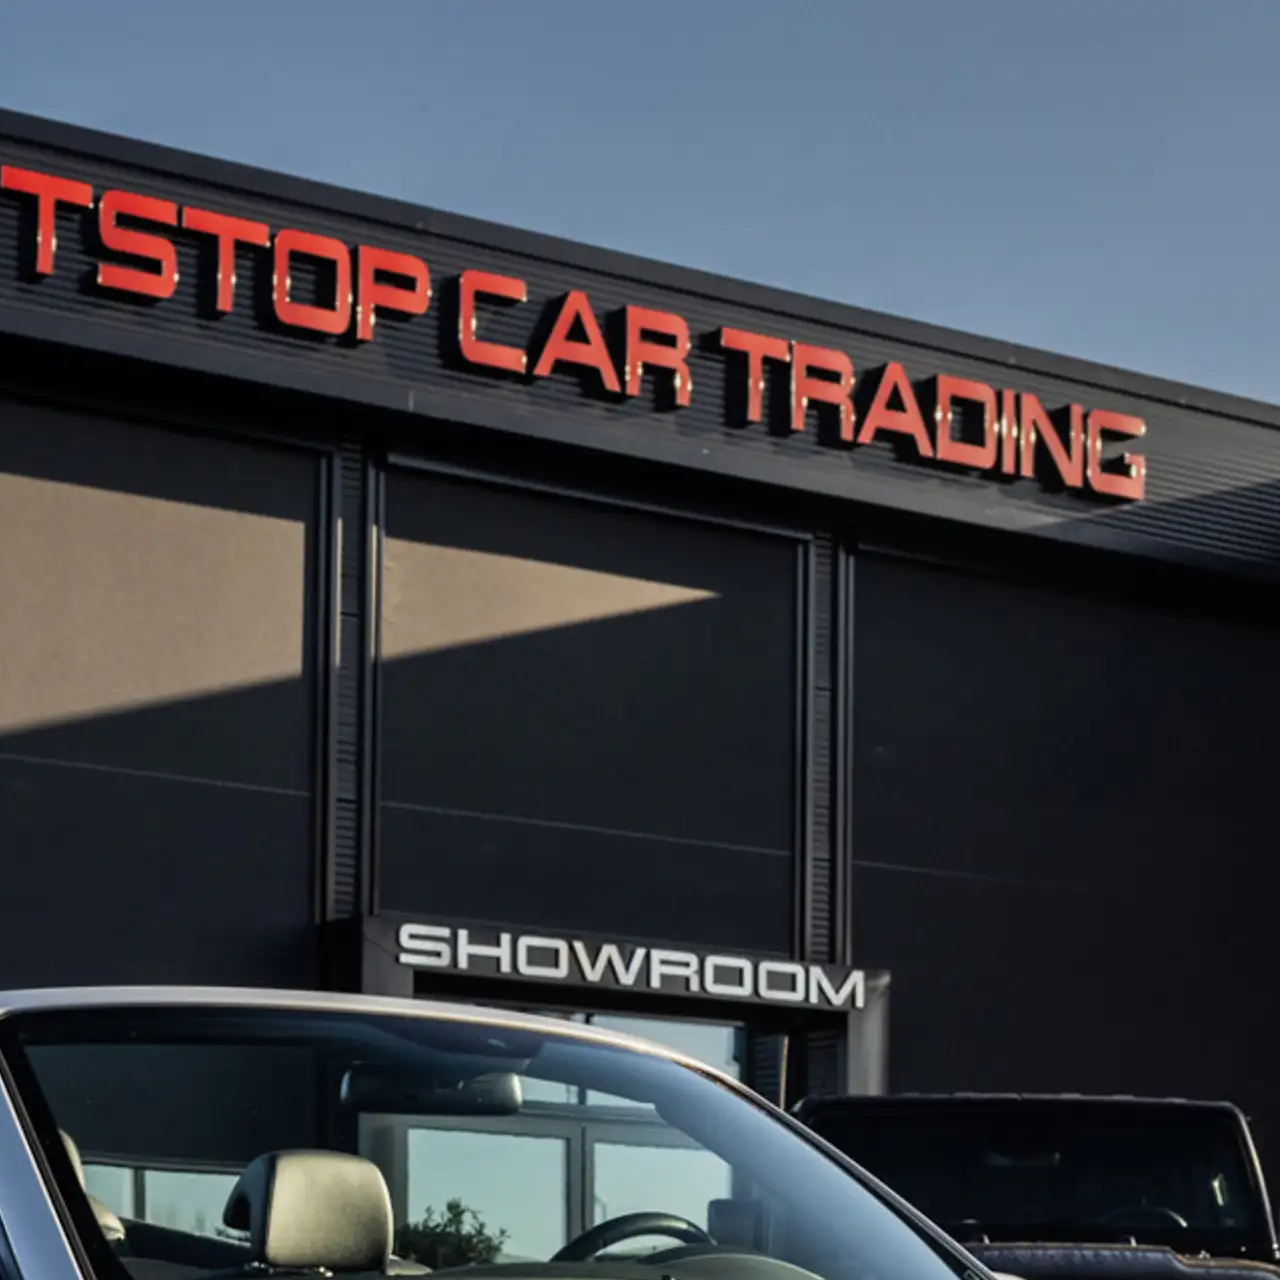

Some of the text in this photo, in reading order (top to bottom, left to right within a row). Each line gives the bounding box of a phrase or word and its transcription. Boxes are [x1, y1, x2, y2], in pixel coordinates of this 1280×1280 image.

[459, 268, 691, 407] CAR
[721, 327, 1146, 501] TRADING
[398, 922, 866, 1009] SHOWROOM
